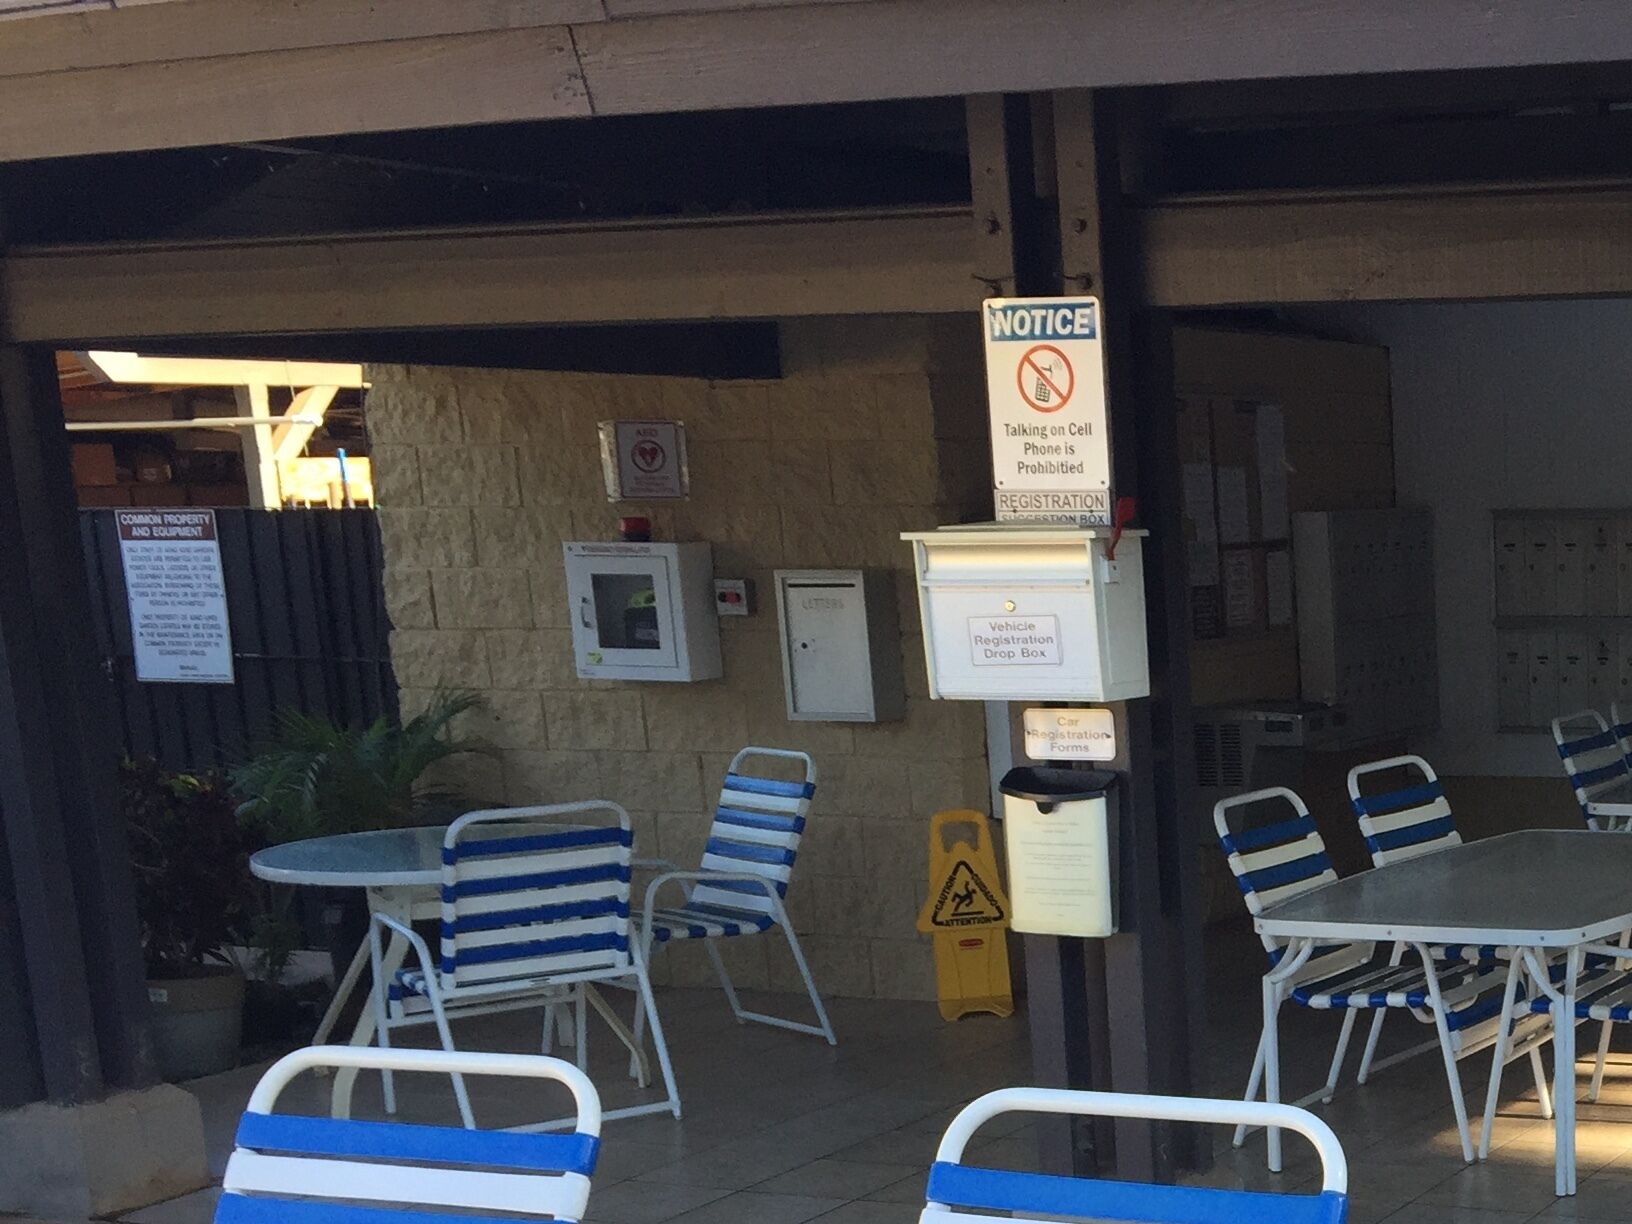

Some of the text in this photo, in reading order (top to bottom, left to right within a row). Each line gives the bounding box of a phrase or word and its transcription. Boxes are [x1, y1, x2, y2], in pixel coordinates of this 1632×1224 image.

[992, 308, 1091, 336] NOTICE
[1004, 422, 1092, 439] Talking on Cell
[1024, 442, 1075, 455] Phone is
[1017, 460, 1084, 474] Prohibitied
[1000, 494, 1104, 508] REGISTRATION
[121, 514, 210, 525] COMMON PROPERTY
[1080, 515, 1105, 524] BOX
[132, 526, 203, 537] AND EQUIPMENT
[989, 621, 1036, 631] Vehicle
[975, 635, 1054, 647] Registration
[984, 648, 1047, 660] Drop Box
[1057, 717, 1080, 726] Car
[1031, 729, 1107, 740] Registration
[1050, 743, 1089, 752] Forms
[935, 874, 956, 911] CAUTION
[944, 916, 992, 927] ATTENTION
